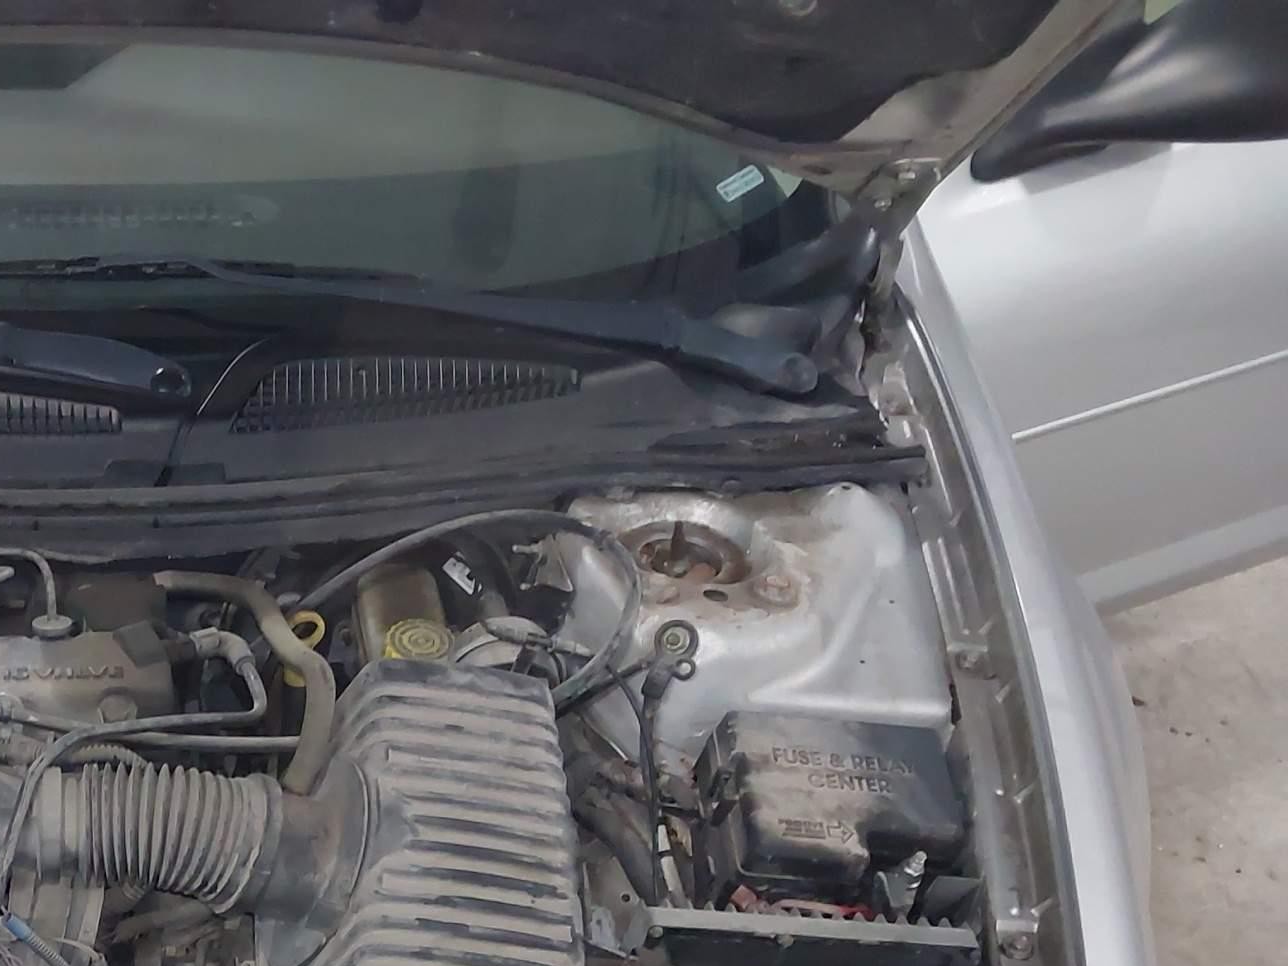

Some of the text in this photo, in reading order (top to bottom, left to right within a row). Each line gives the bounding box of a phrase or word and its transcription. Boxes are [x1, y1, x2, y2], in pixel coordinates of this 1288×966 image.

[772, 747, 913, 774] FUSE & RELAY
[808, 772, 892, 793] CENTER
